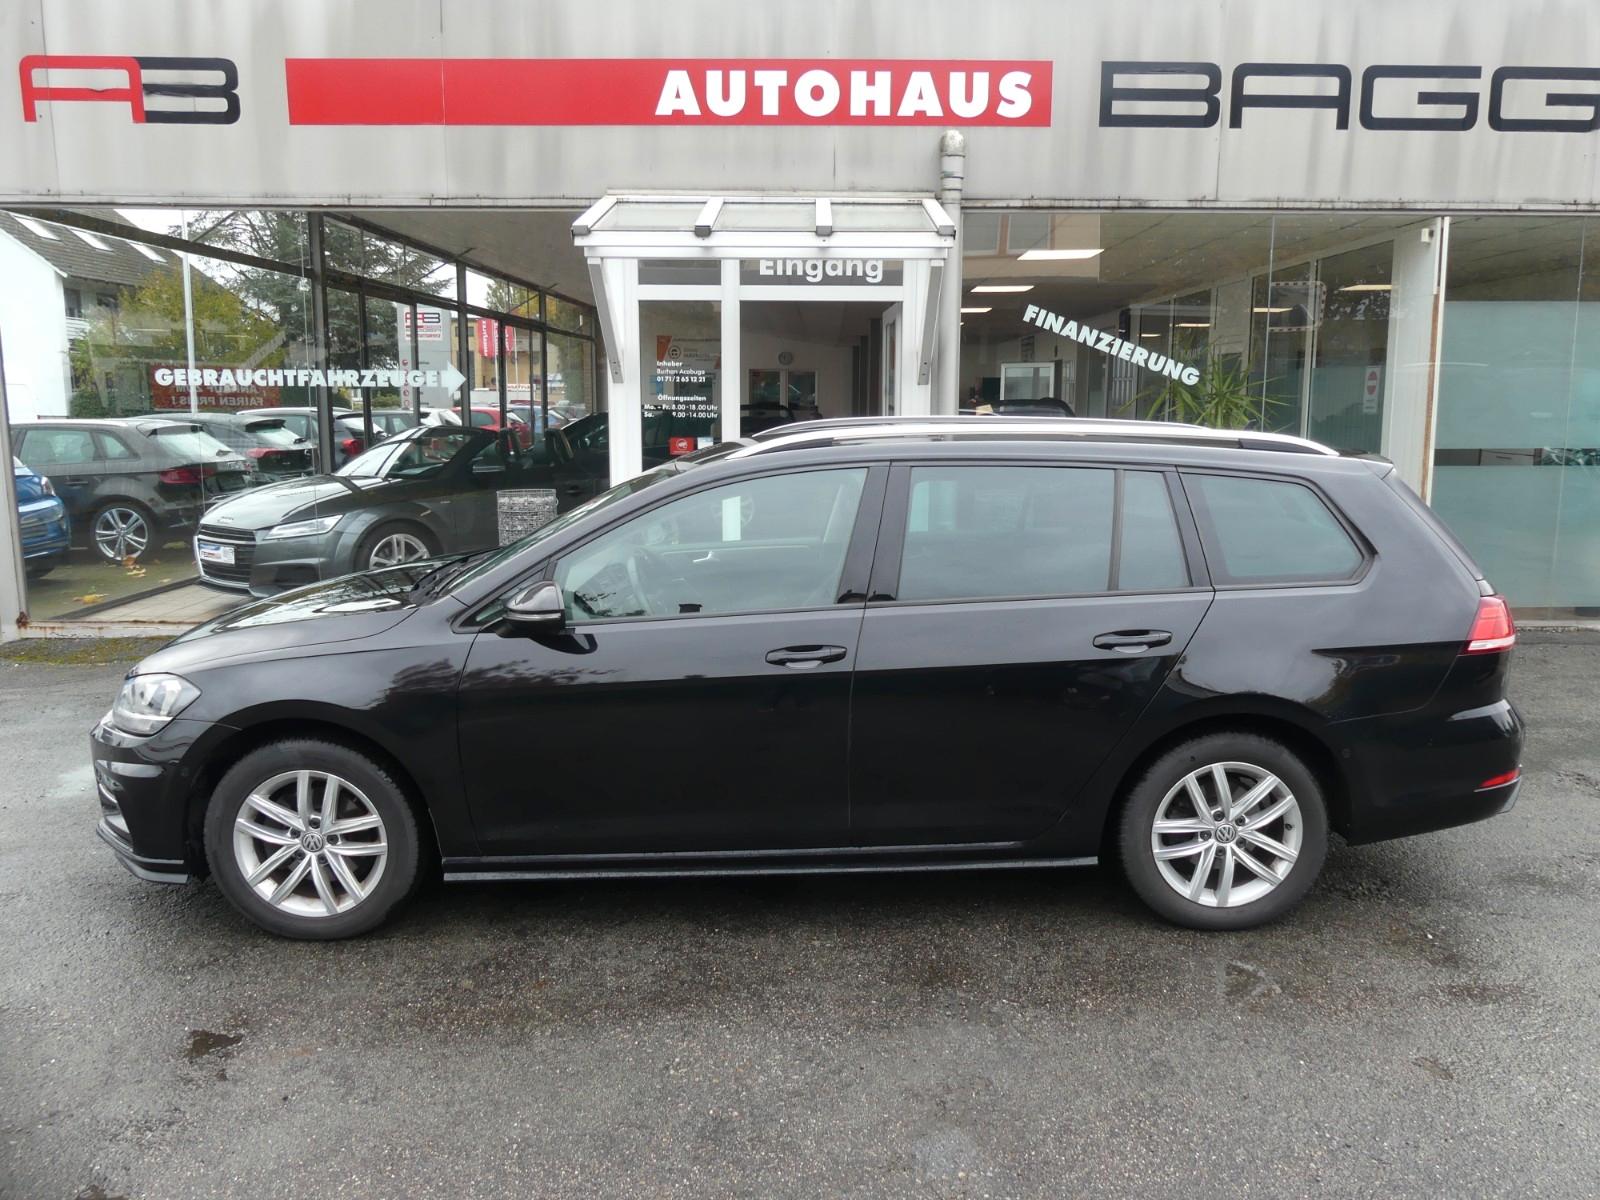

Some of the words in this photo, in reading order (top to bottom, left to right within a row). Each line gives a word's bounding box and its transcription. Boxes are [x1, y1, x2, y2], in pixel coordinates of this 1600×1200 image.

[19, 55, 240, 124] AB
[654, 69, 1033, 118] AUTOHAUS
[759, 259, 883, 283] Eingang
[1022, 304, 1200, 386] FINANZIERUNG
[154, 368, 438, 387] GEBRAUCHTFAHRZEUGE
